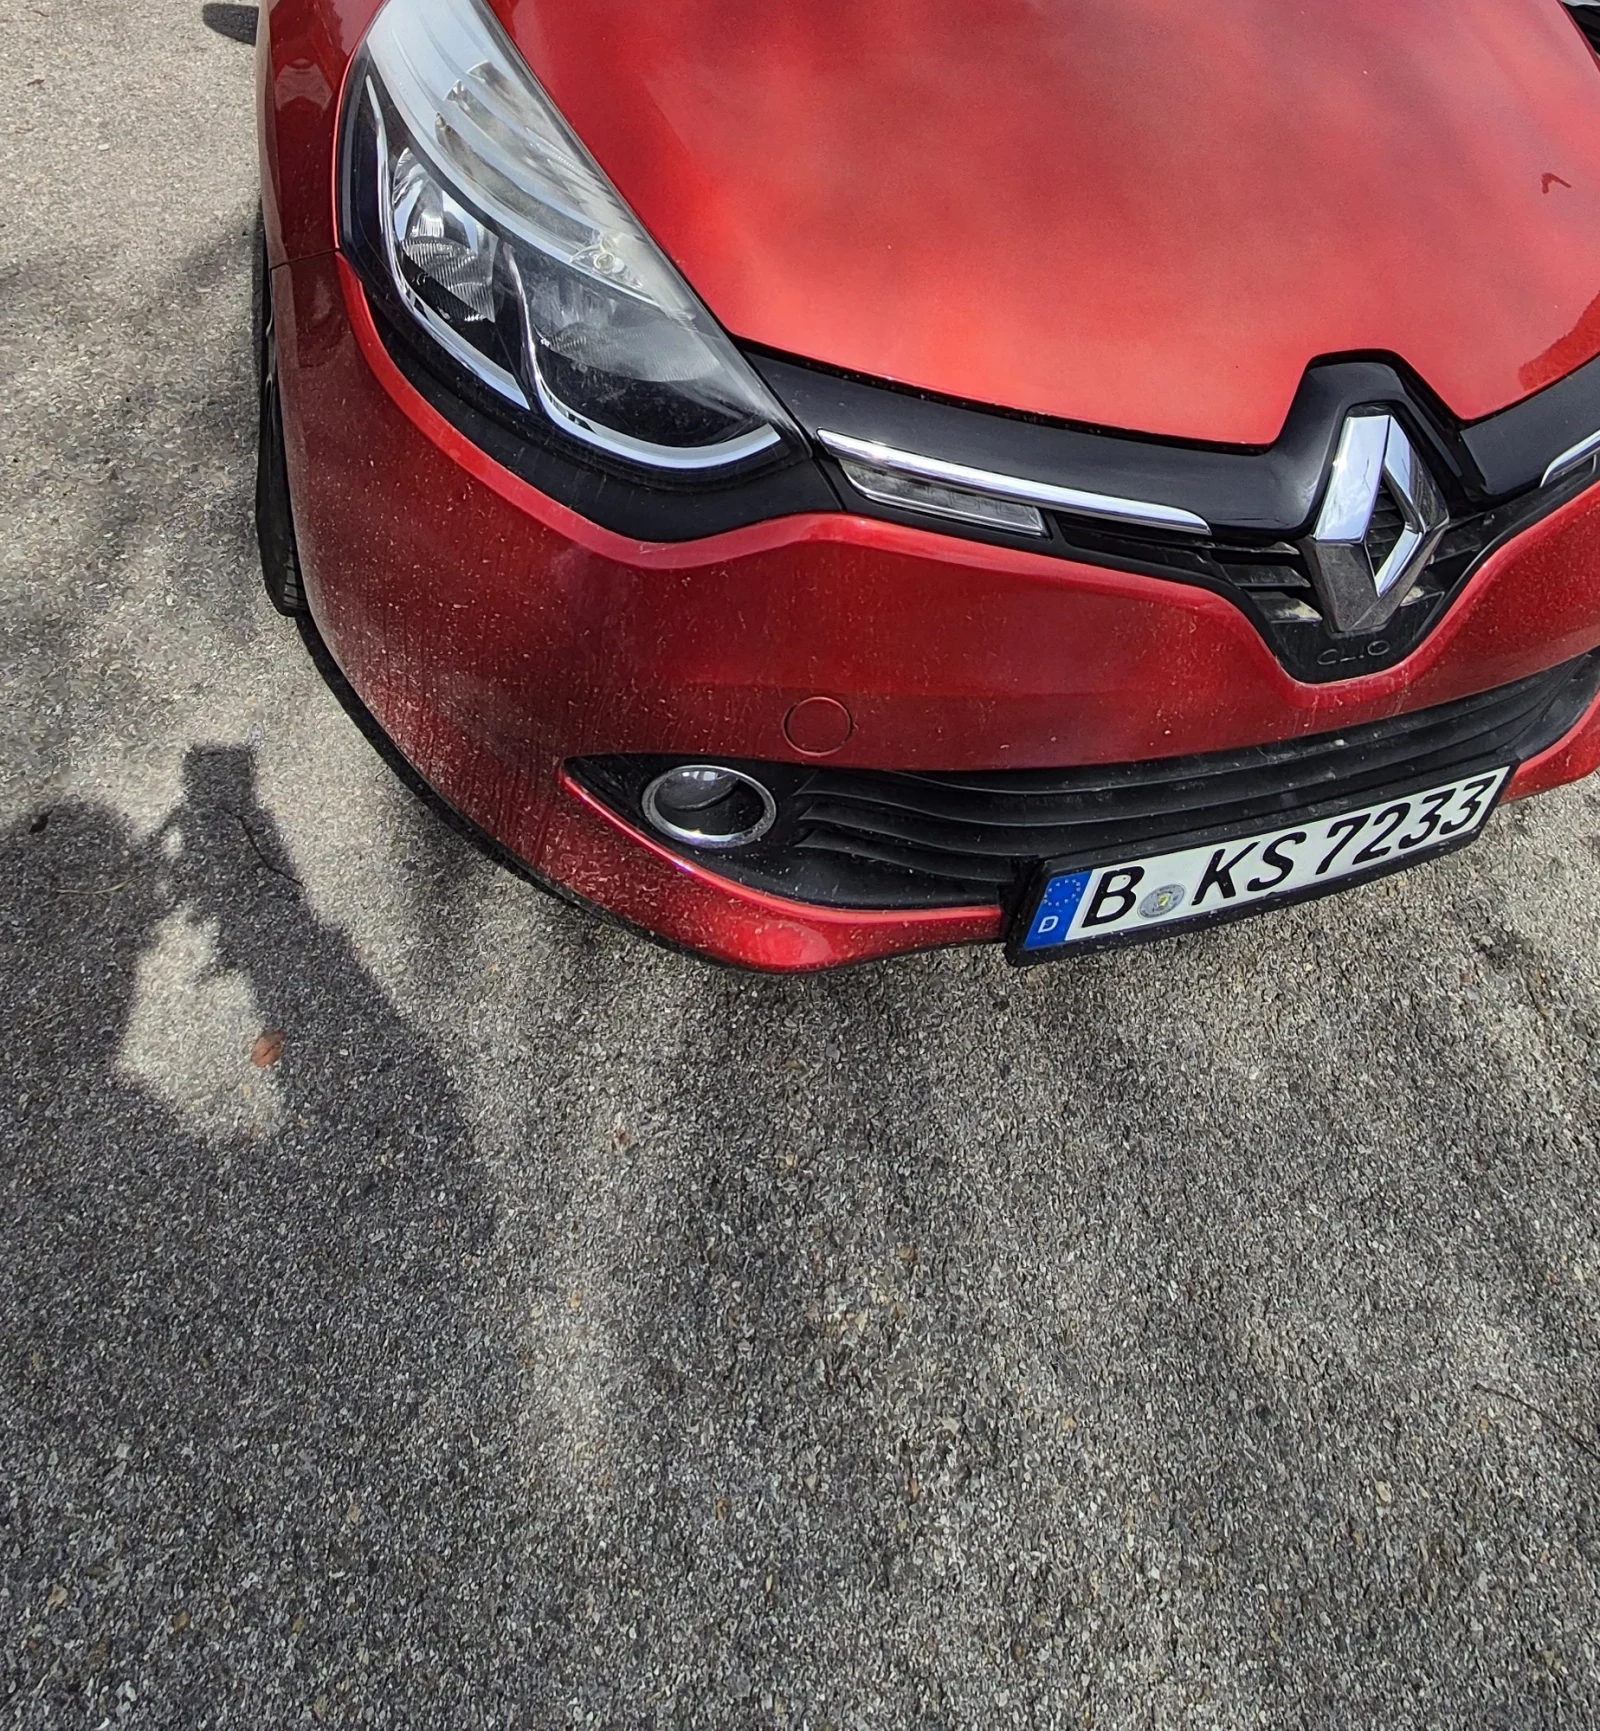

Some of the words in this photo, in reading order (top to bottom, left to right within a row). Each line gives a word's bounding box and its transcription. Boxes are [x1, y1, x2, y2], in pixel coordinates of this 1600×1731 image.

[1316, 639, 1391, 666] CLIO
[1080, 865, 1146, 929] B
[1190, 831, 1308, 906] KS
[1315, 774, 1498, 876] 7233
[1037, 915, 1060, 934] D
